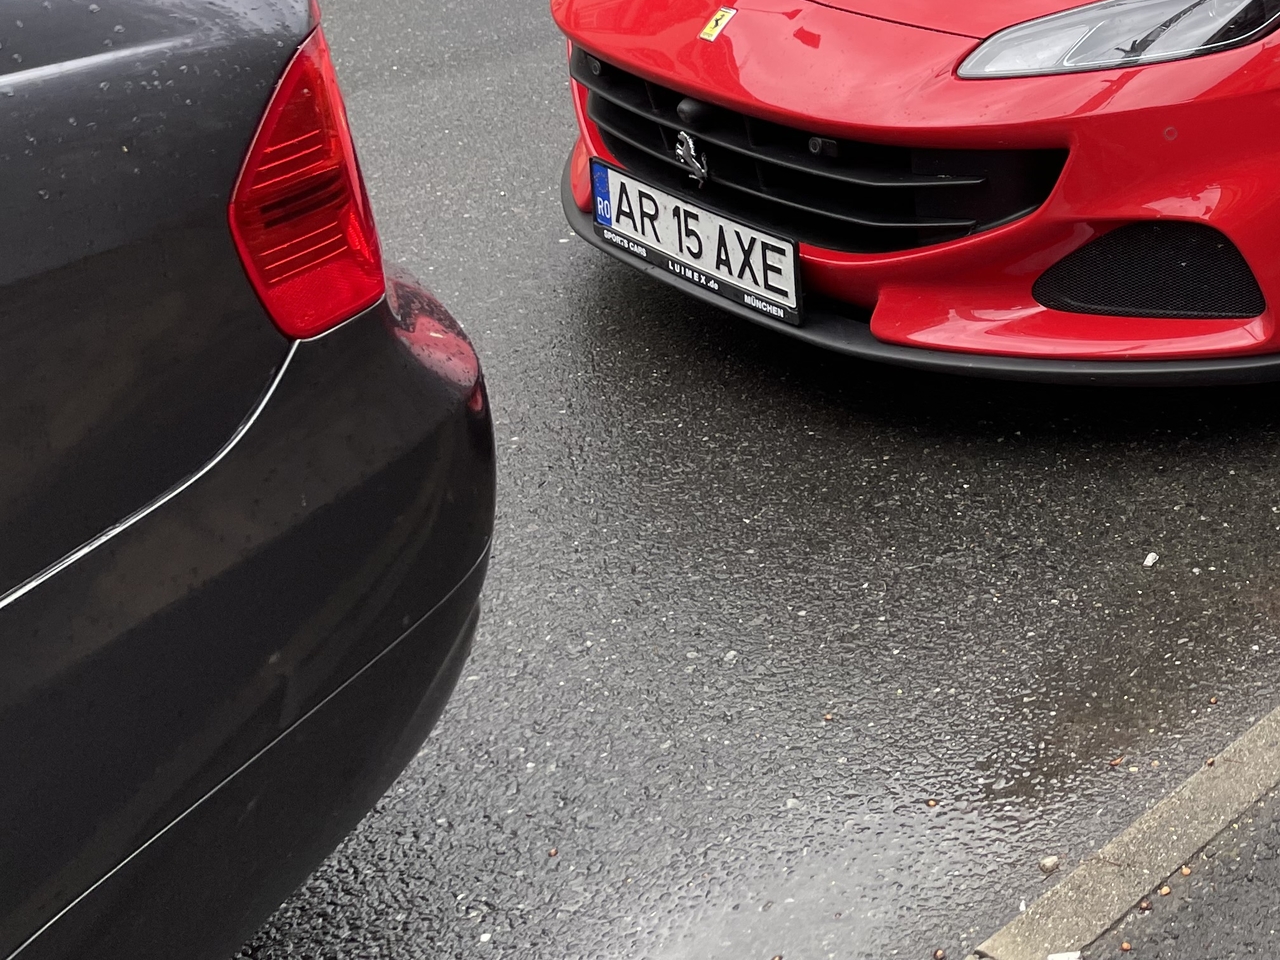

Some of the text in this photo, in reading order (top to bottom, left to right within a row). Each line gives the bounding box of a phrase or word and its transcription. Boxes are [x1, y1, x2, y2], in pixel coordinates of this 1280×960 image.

[597, 196, 611, 219] RO
[603, 229, 647, 257] SPORTS CARS
[615, 181, 789, 298] AR 15 AXE
[744, 293, 784, 318] MÜNCHEN
